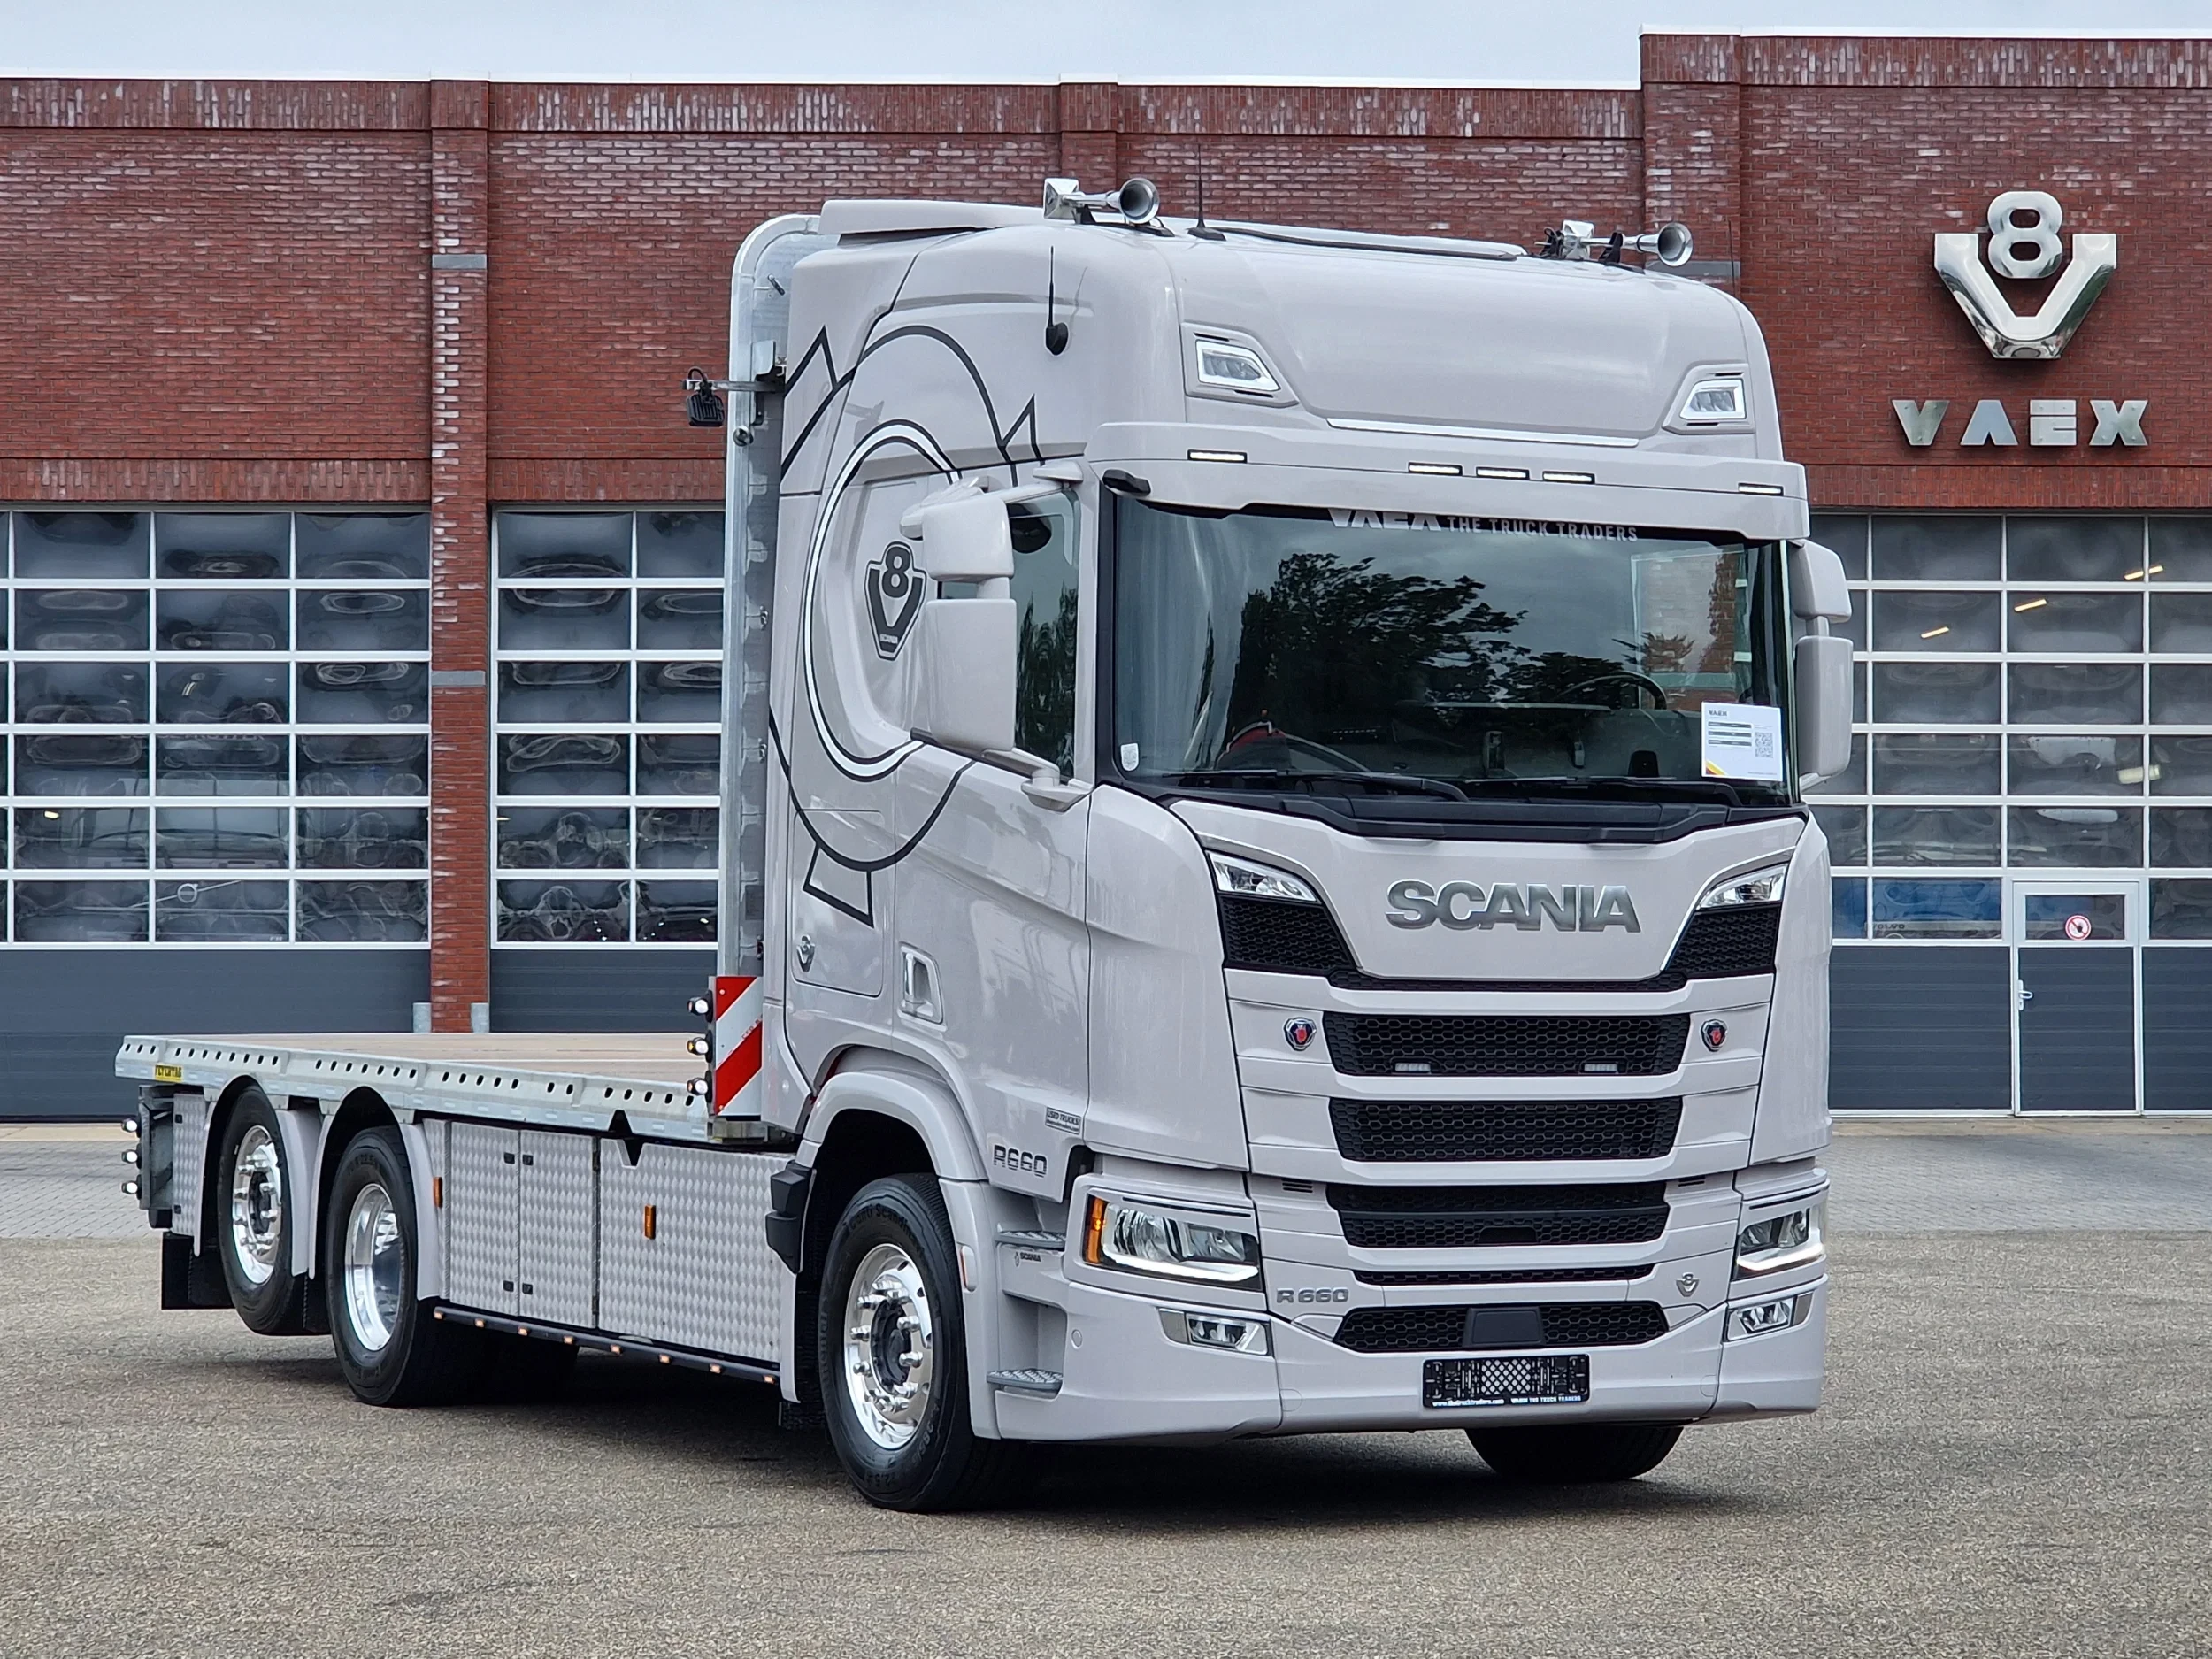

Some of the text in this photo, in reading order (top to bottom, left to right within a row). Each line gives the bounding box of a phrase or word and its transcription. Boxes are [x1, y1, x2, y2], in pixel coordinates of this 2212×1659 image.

[1892, 399, 2148, 446] VAEX
[1447, 516, 1481, 534] THE
[1489, 518, 1548, 537] TRUCK
[1556, 522, 1637, 542] TRADERS
[1385, 879, 1641, 933] SCANIA
[994, 1144, 1047, 1178] R660
[1019, 1251, 1041, 1262] SCANIA
[1276, 1287, 1349, 1303] R 660
